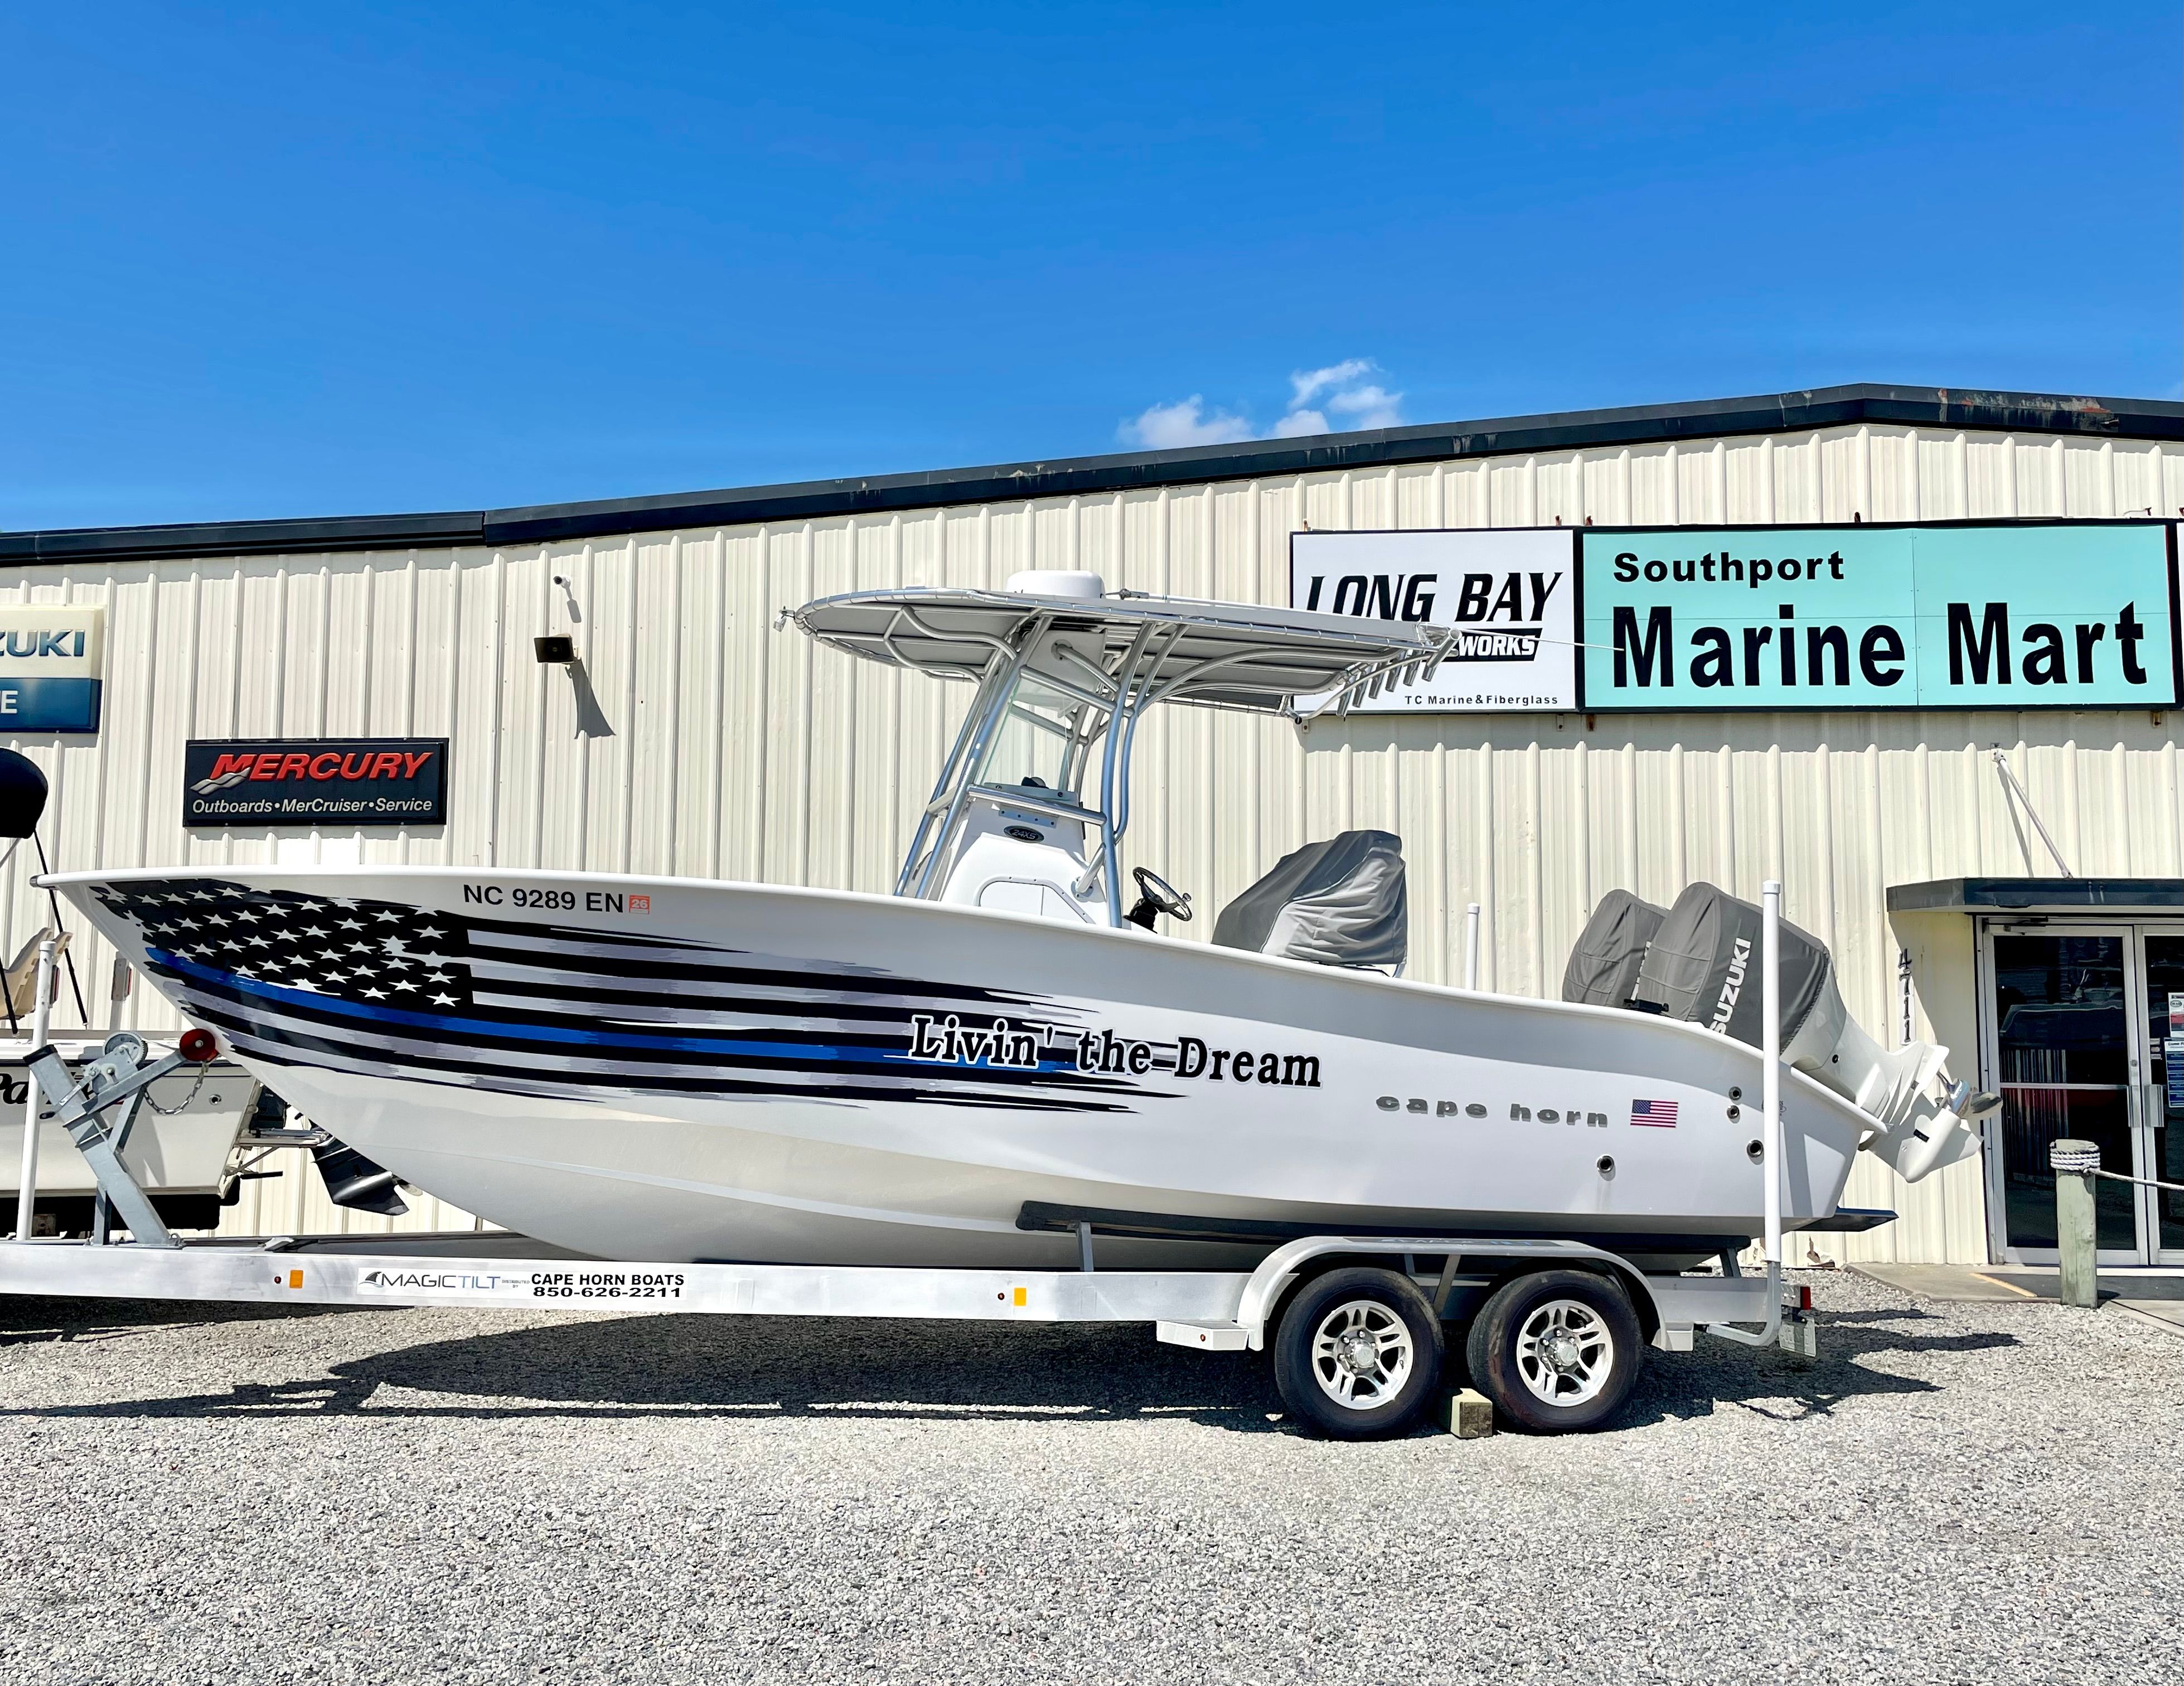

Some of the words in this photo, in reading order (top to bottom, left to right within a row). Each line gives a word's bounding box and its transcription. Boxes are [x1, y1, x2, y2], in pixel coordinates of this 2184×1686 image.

[1613, 550, 1844, 589] Southport
[1455, 571, 1563, 622] BAY
[0, 629, 85, 657] UKI
[1613, 604, 1906, 688] Marine
[1947, 600, 2148, 686] Mart
[1405, 696, 1422, 704] TC
[210, 752, 434, 781] MERCURY
[463, 884, 503, 905] NC
[512, 888, 576, 910] 9289
[586, 892, 623, 913] EN
[631, 899, 648, 909] 26
[1709, 938, 1751, 1035] SUZUKI
[1898, 948, 1912, 1043] 4711
[908, 1014, 1055, 1069] Livin'
[1076, 1028, 1154, 1075] the
[1174, 1036, 1323, 1088] Dream
[1376, 1096, 1488, 1118] cape
[1510, 1103, 1608, 1128] horn
[531, 1273, 573, 1285] CAPE
[580, 1275, 625, 1285] HORN
[632, 1275, 685, 1286] BOATS
[533, 1287, 680, 1297] 850-626-2211
